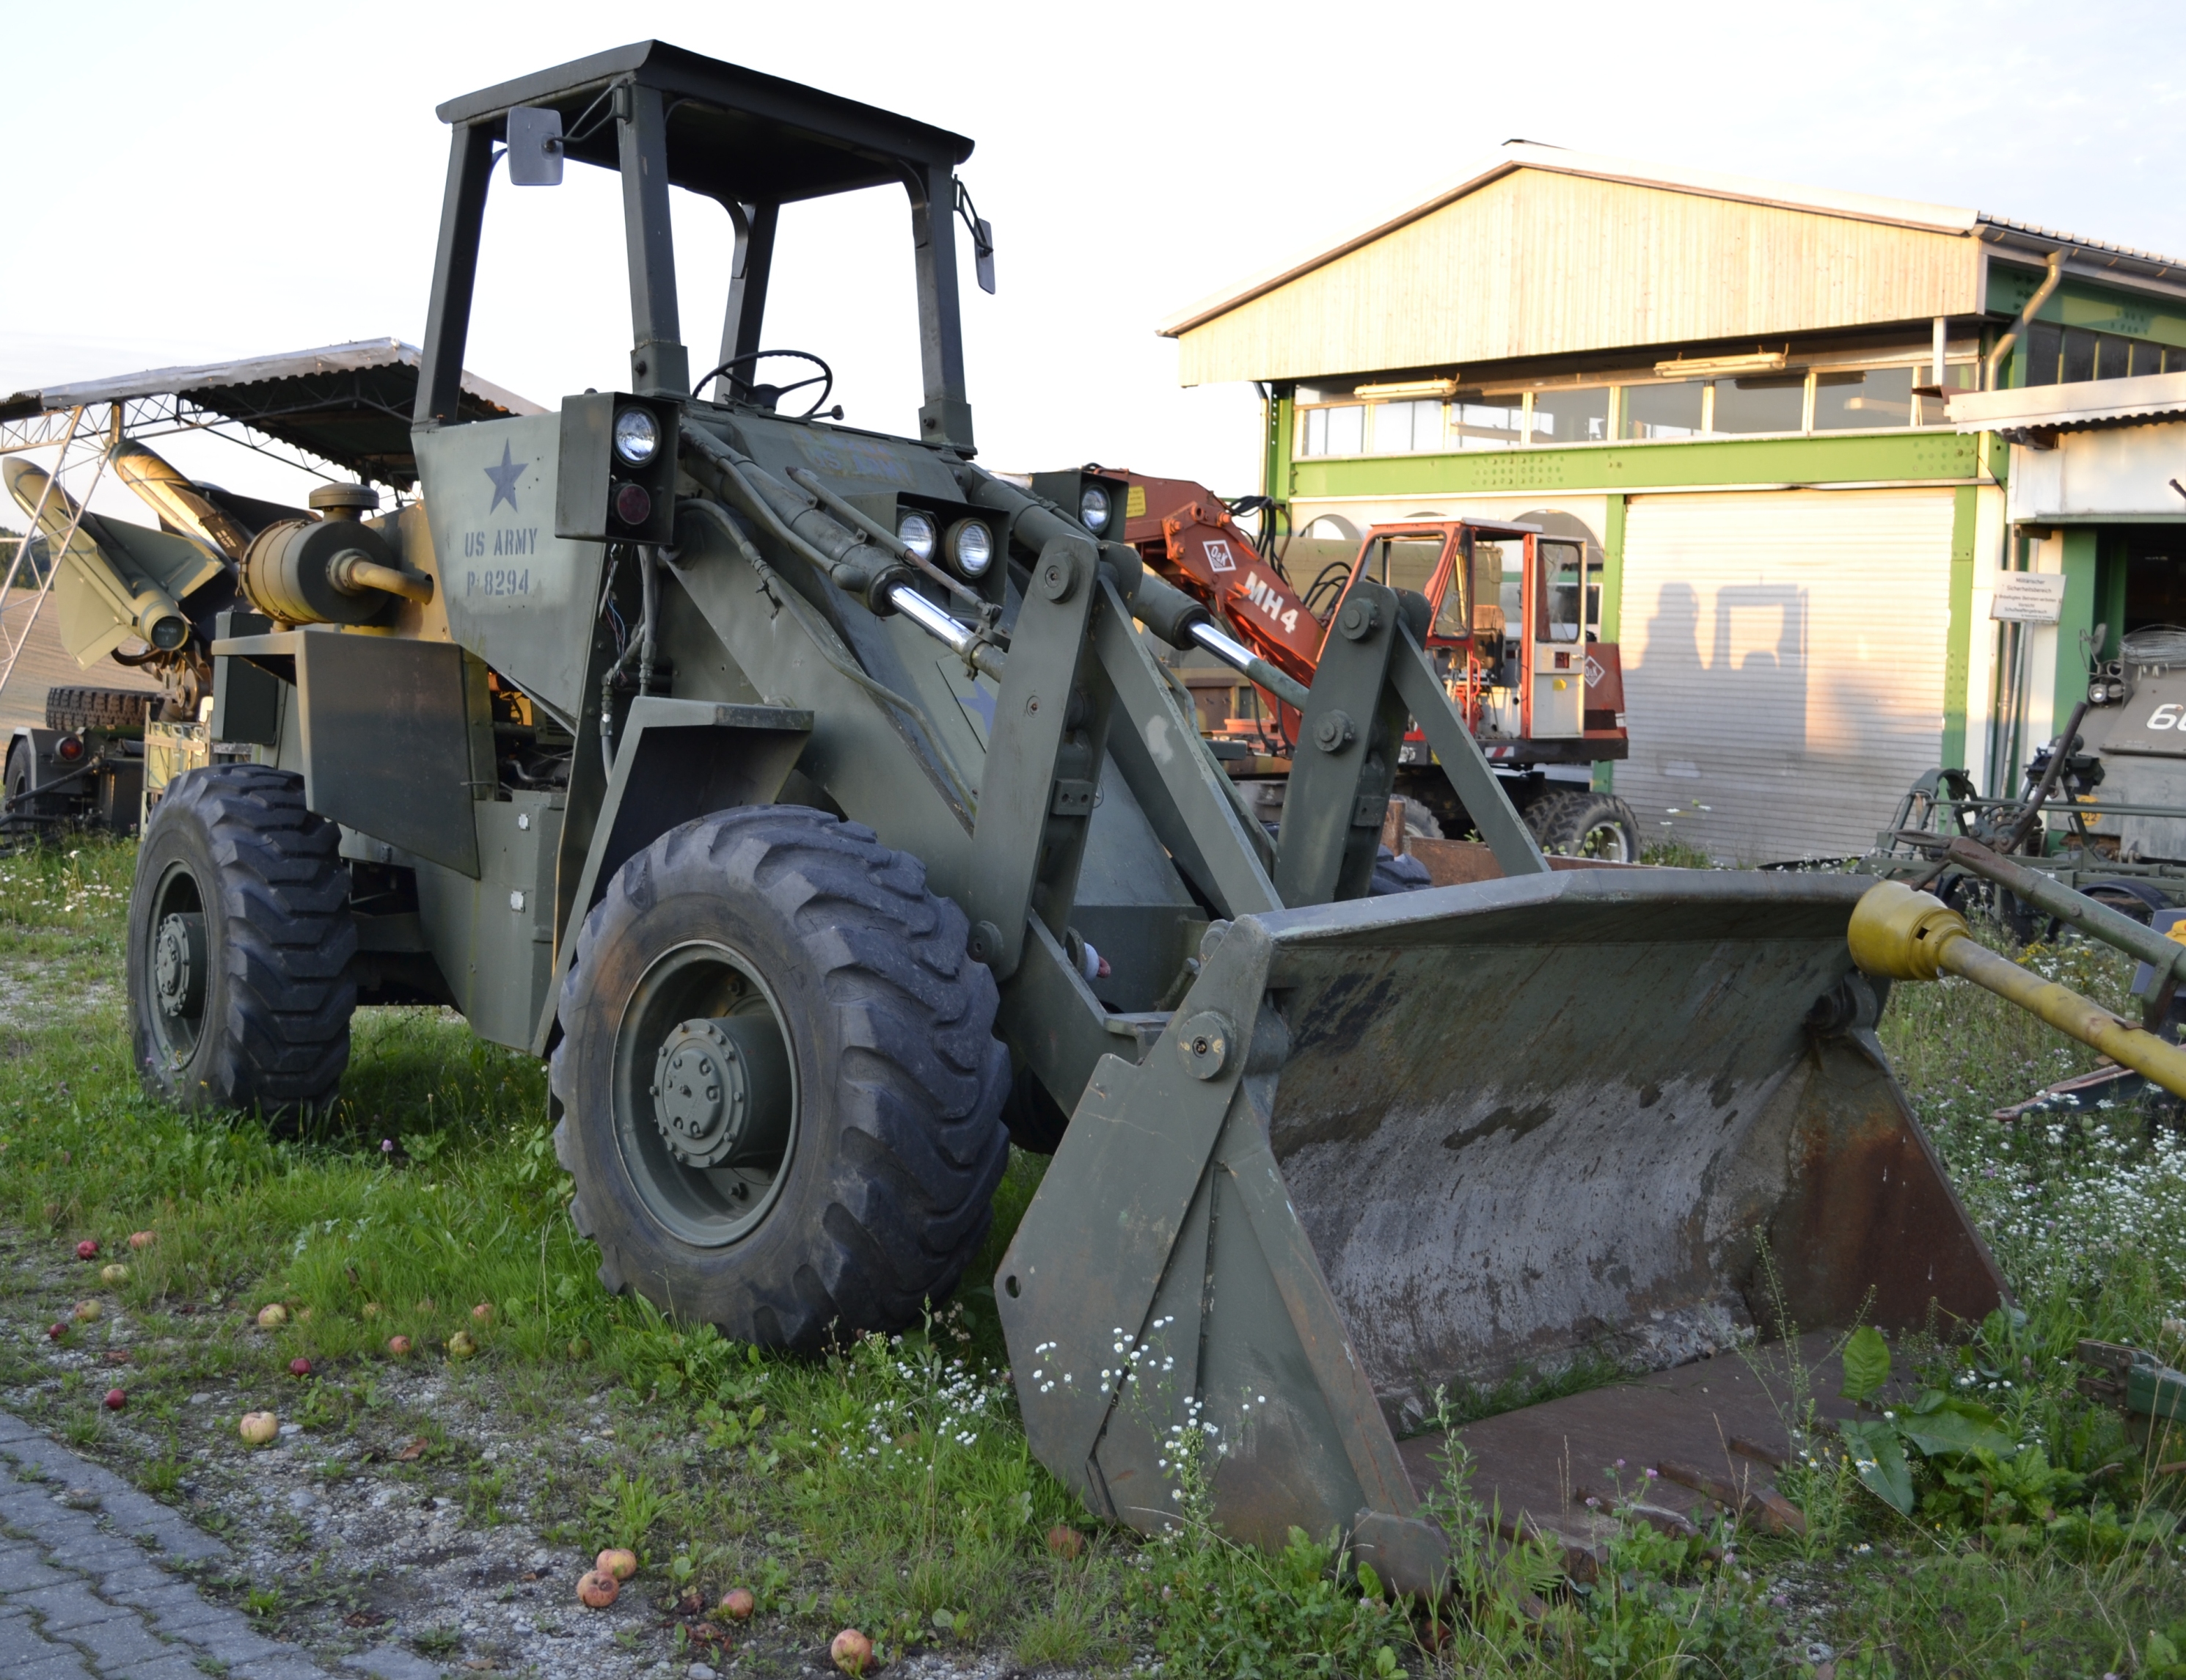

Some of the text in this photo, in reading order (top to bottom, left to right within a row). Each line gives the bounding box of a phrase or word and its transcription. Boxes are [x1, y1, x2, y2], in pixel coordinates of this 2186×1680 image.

[807, 448, 842, 470] US
[465, 527, 538, 558] US ARMY
[1210, 545, 1229, 566] O&K
[467, 569, 529, 597] P 8294
[2006, 585, 2052, 594] Sicherheitsbereich
[2016, 577, 2045, 585] Militärischer
[2146, 703, 2186, 731] 6
